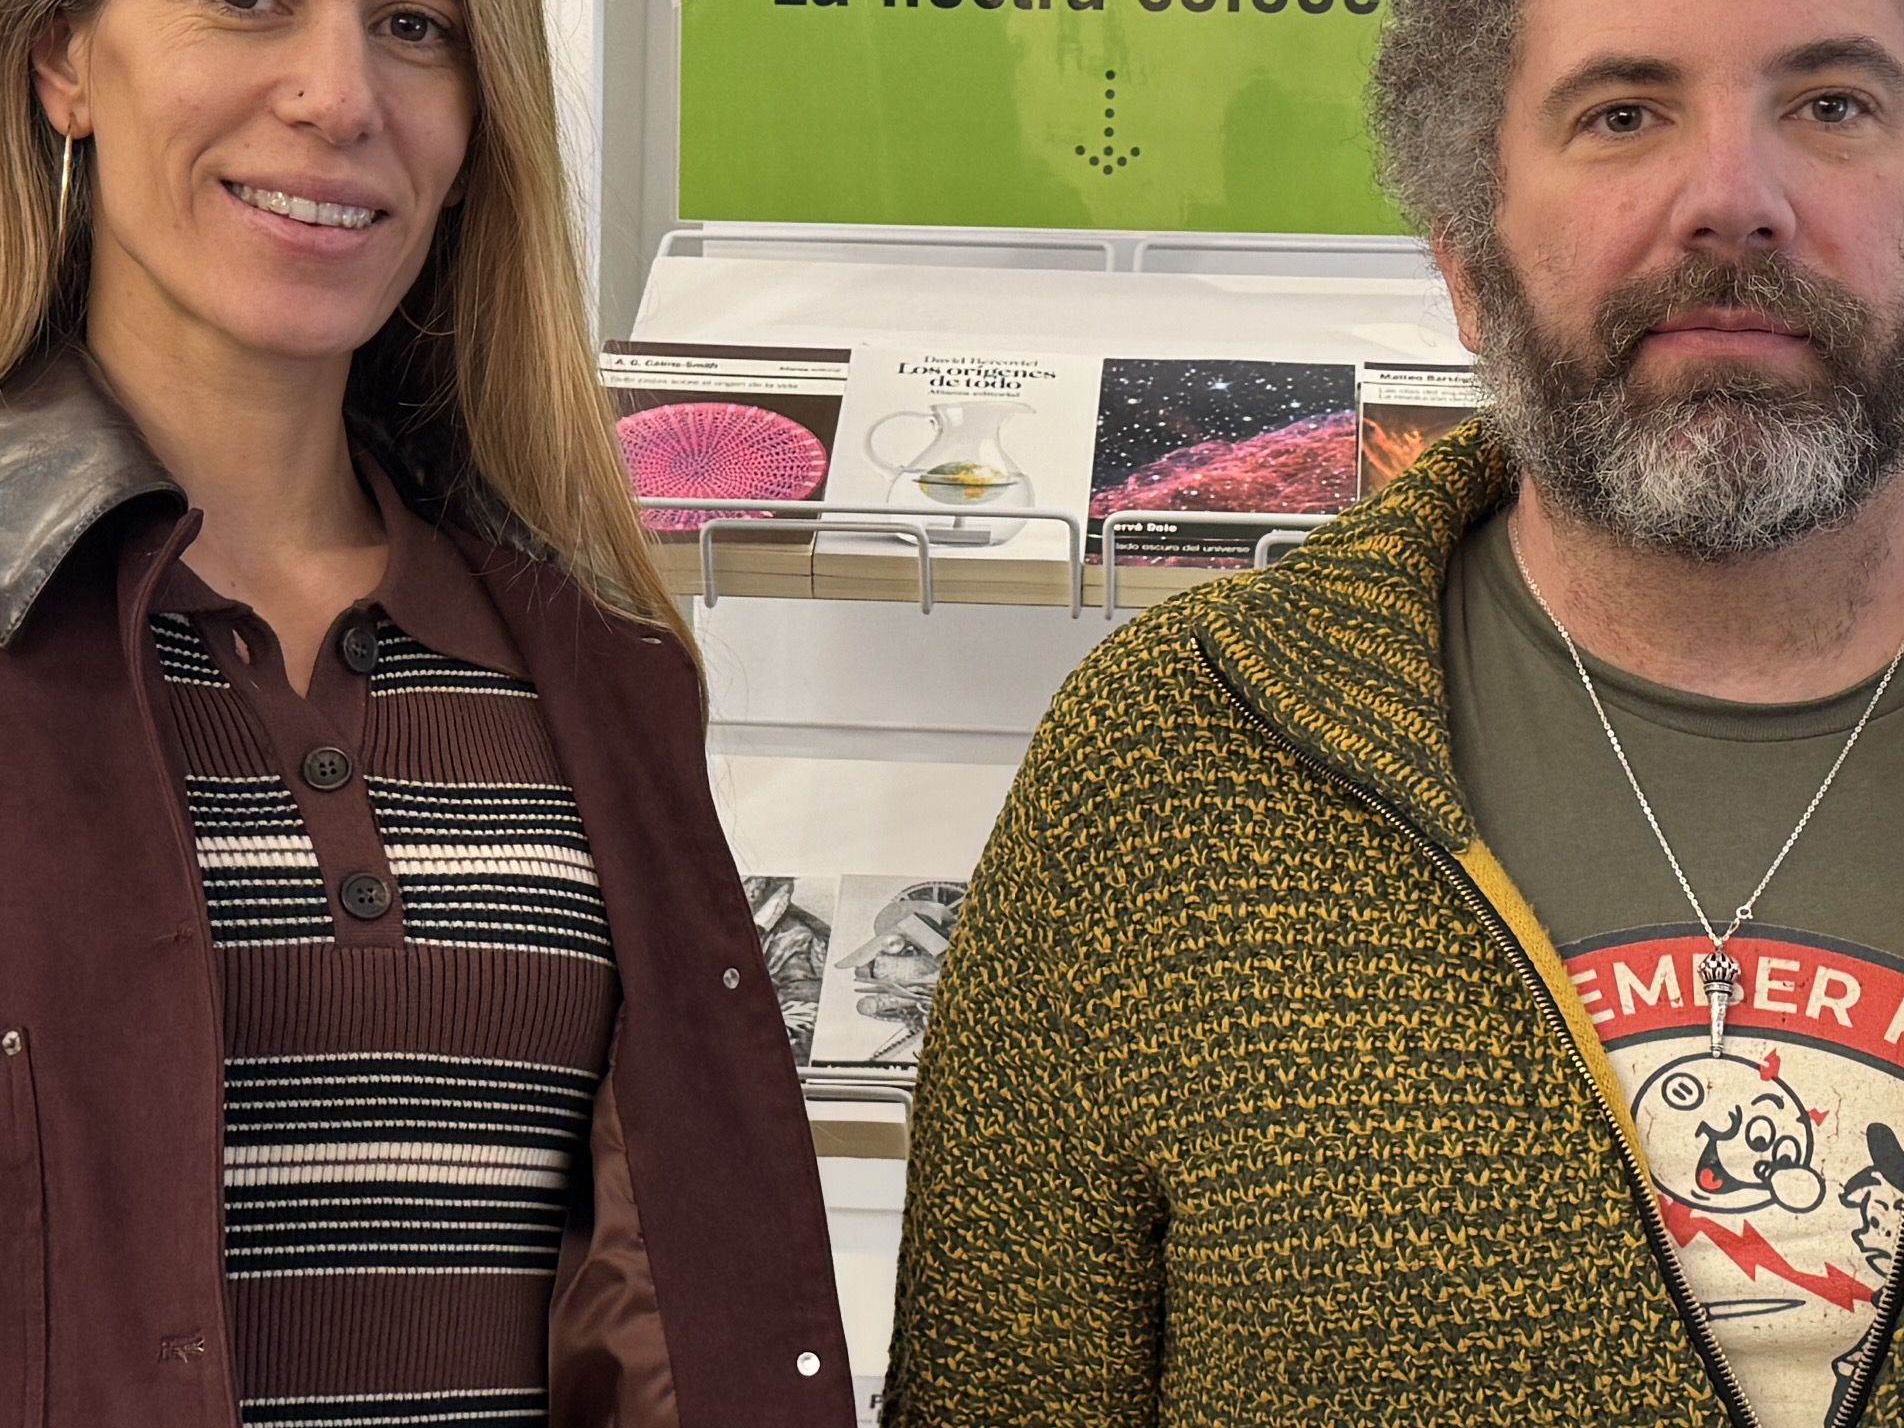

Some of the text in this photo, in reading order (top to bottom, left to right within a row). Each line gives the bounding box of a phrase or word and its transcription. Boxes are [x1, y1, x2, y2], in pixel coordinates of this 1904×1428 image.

[898, 362, 941, 375] Los
[929, 376, 1022, 389] de todo
[1113, 523, 1143, 532] ervé
